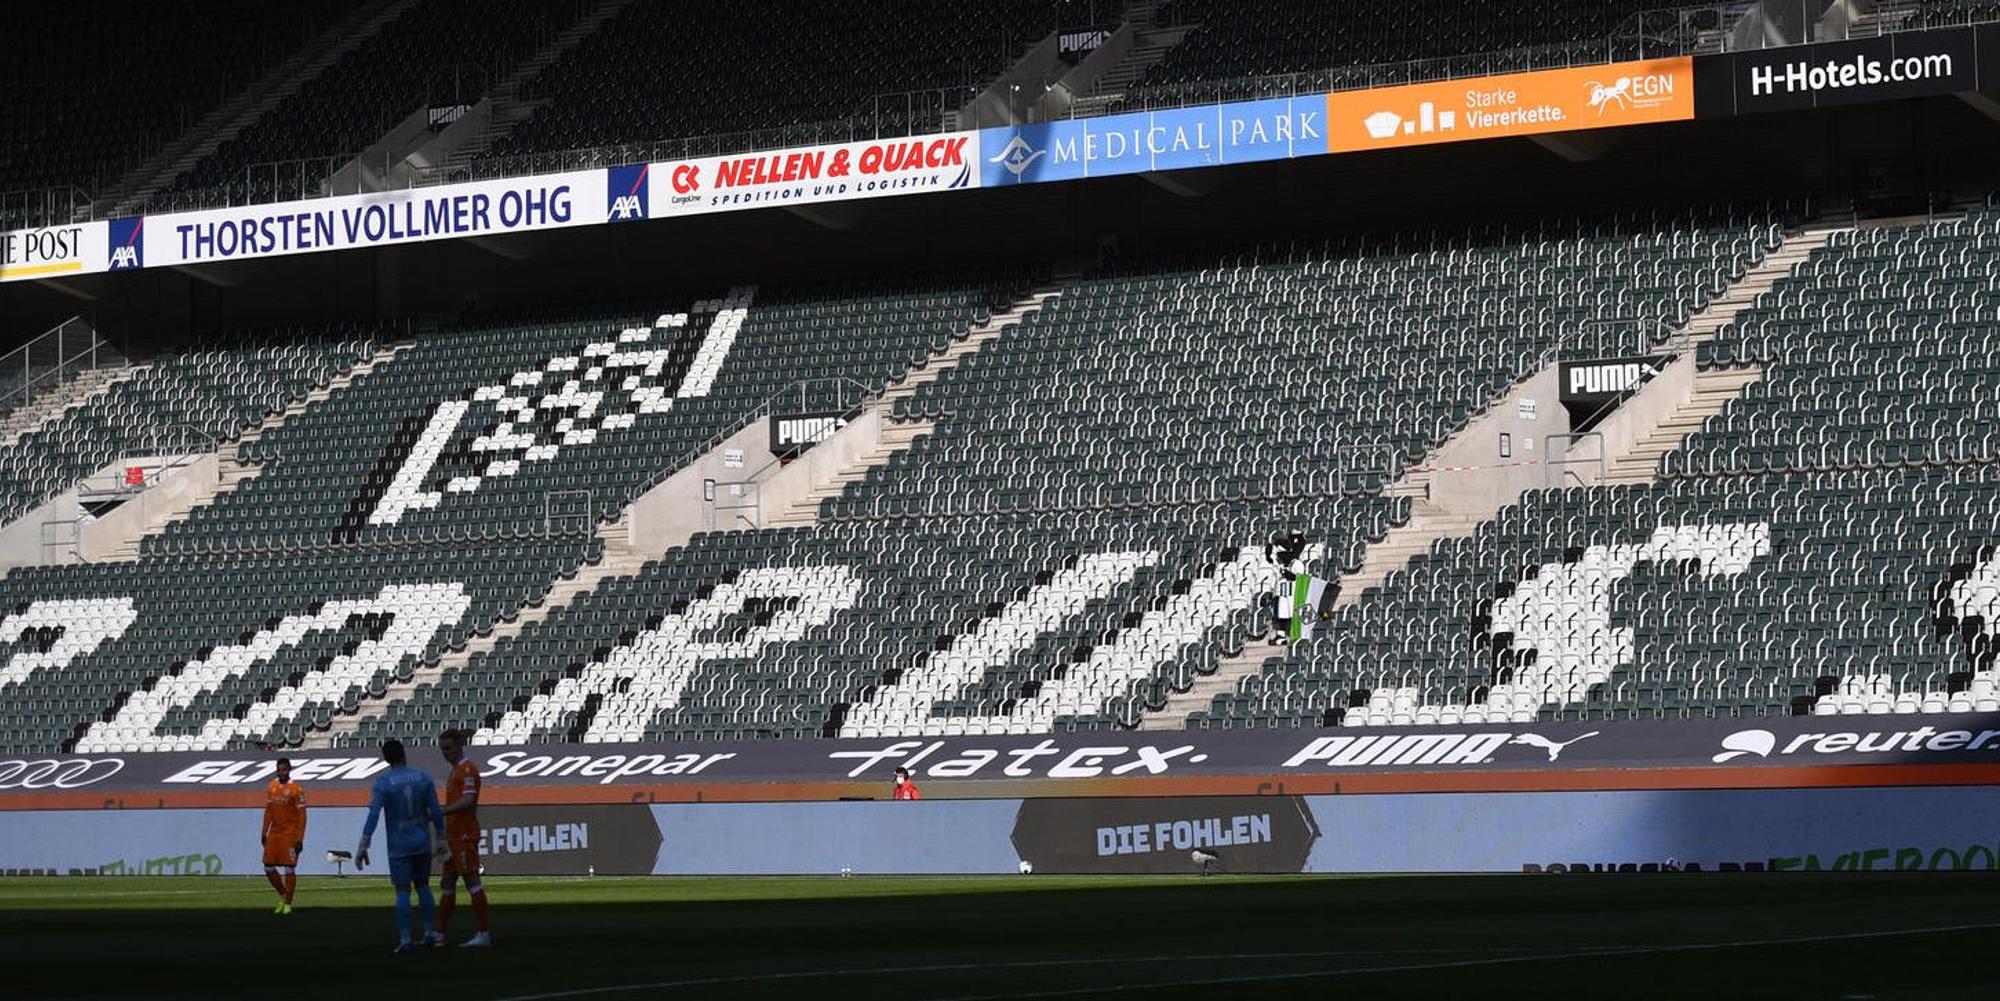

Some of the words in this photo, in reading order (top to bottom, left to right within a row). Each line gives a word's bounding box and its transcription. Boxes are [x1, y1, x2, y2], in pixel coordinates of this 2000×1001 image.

[1632, 74, 1673, 97] EGN
[1751, 53, 1952, 96] H-Hotels.com
[1466, 88, 1516, 109] Starke
[1466, 106, 1567, 129] Viererkette.
[1054, 123, 1211, 164] MEDICAL
[1231, 111, 1320, 146] PARK
[713, 150, 823, 189] NELLEN
[827, 148, 850, 176] &
[858, 136, 970, 175] QUACK
[711, 187, 803, 206] SPEDITION
[812, 183, 848, 197] UND
[857, 174, 940, 192] LOGISTIK
[176, 209, 334, 260] THORSTEN
[342, 193, 490, 244] VOLLMER
[499, 186, 571, 228] OHG
[608, 195, 643, 219] AXA
[0, 234, 17, 265] E
[25, 227, 83, 262] POST
[109, 245, 138, 268] AXA
[1570, 363, 1641, 394] PUMA
[778, 418, 836, 445] PUMA
[162, 757, 390, 784] ELTEN
[479, 751, 737, 784] Sonepar
[1281, 733, 1512, 767] PUMA
[493, 823, 588, 855] FOHLEN
[1097, 824, 1151, 856] DIE
[1155, 813, 1272, 851] FOHLEN
